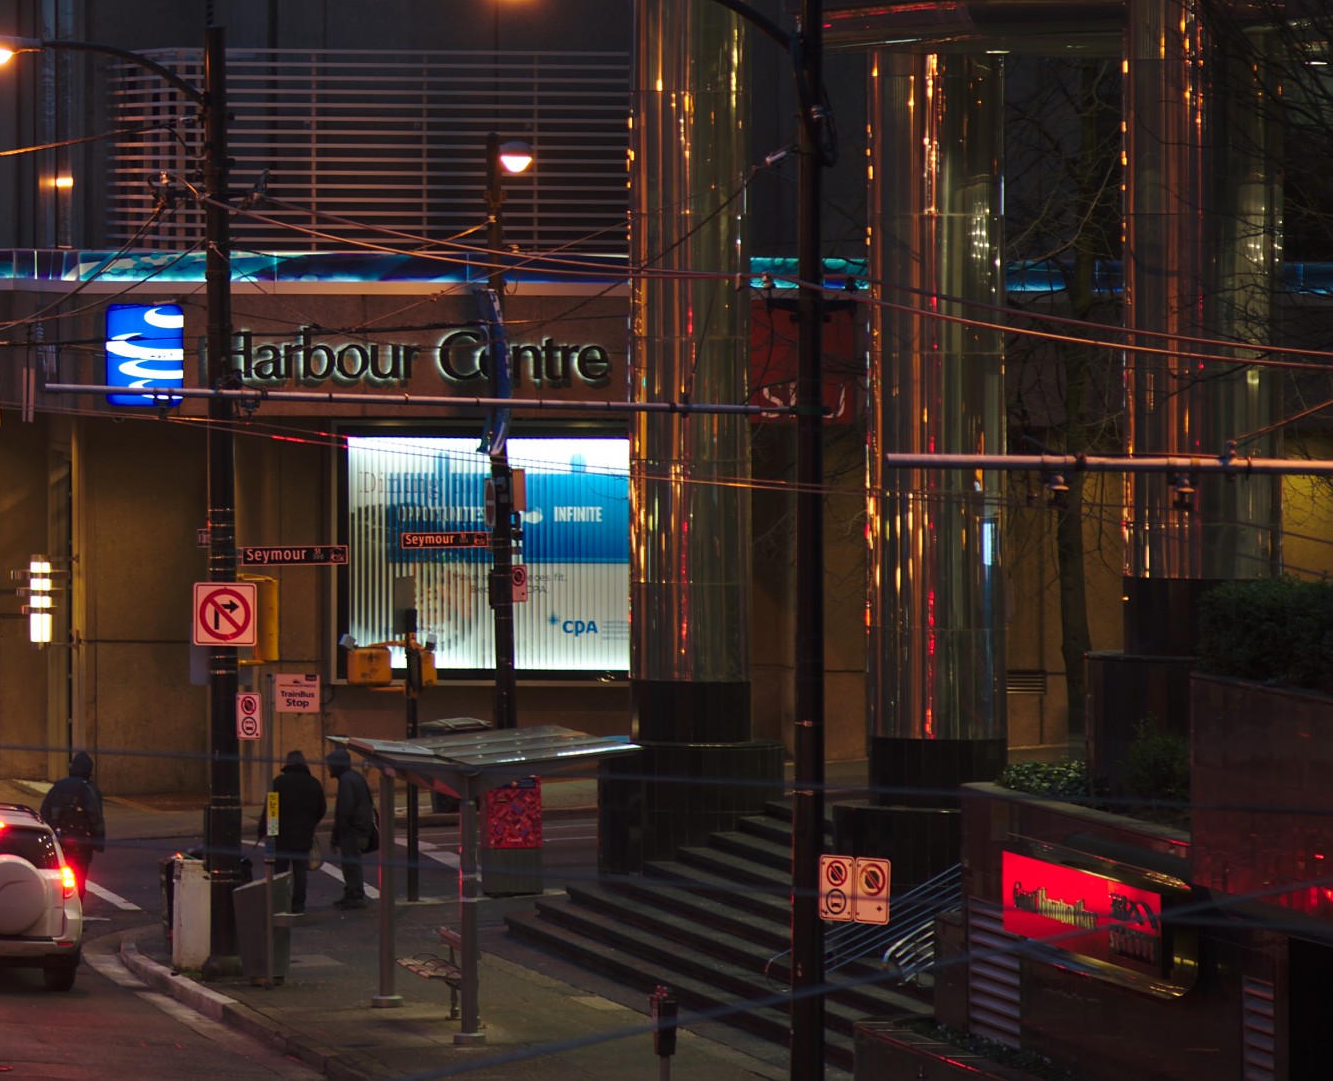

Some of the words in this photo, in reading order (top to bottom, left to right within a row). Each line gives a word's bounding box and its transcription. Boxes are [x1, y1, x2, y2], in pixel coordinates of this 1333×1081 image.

[554, 506, 604, 523] INFINITE
[405, 534, 455, 548] Seymour
[246, 549, 307, 564] Seymour
[280, 690, 315, 698] TrainBus
[286, 699, 310, 709] Stop
